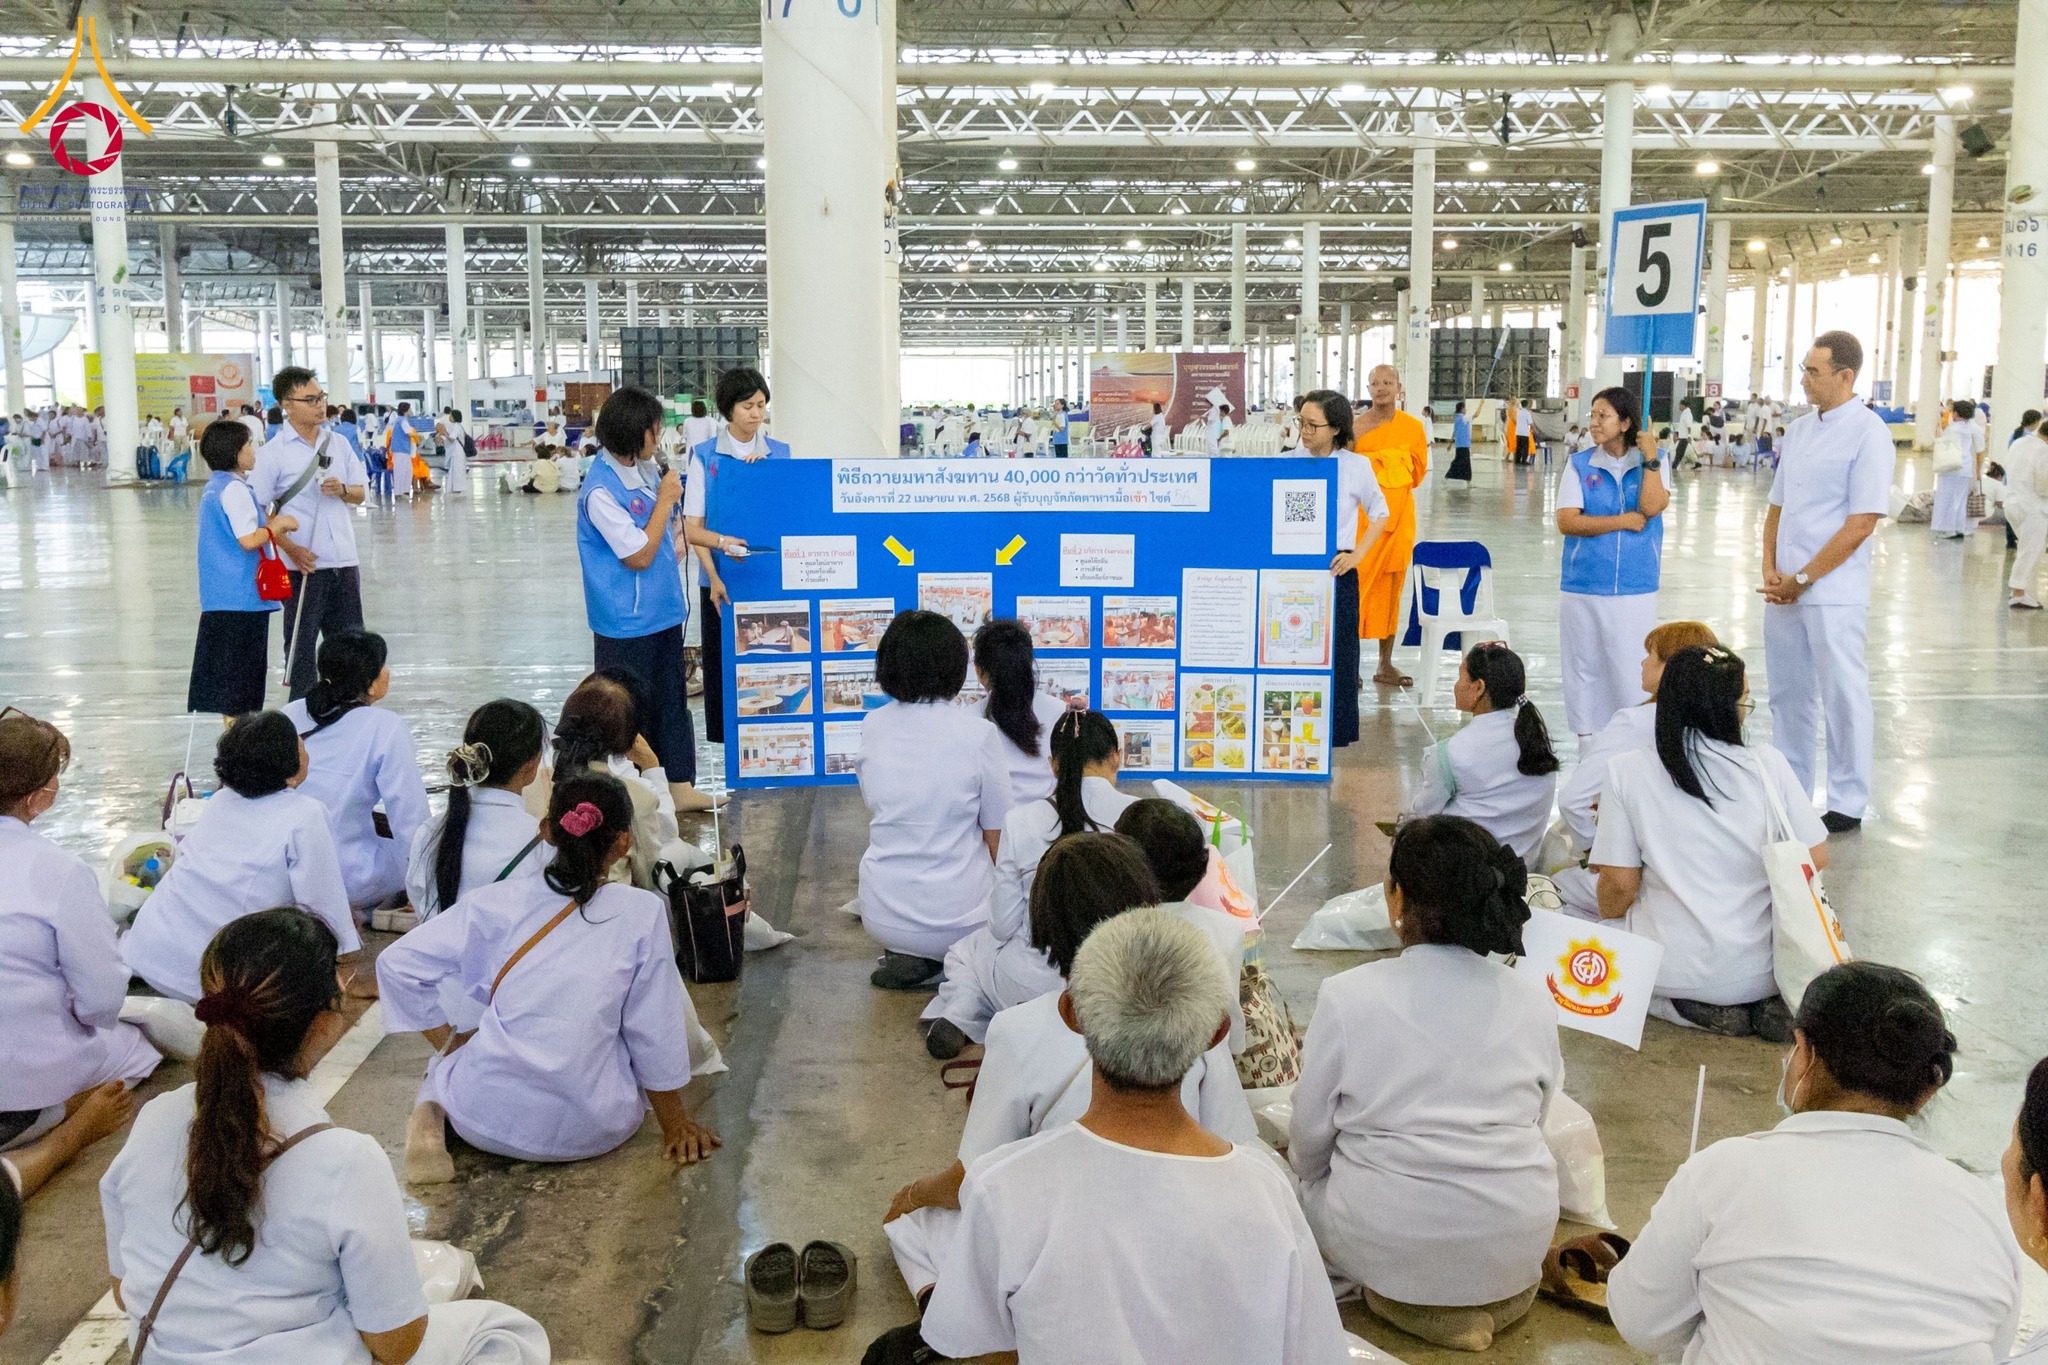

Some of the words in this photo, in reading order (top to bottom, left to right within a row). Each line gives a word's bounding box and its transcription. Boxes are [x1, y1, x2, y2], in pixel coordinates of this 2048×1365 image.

[2018, 243, 2037, 257] 16
[1636, 222, 1672, 308] 5
[837, 466, 999, 485] พิธีถวายมหาสังฆทาน
[1003, 469, 1060, 486] 40,000
[1065, 462, 1198, 484] กว่าวัดทั่วประเทศ
[840, 489, 895, 504] วันอังคารที่
[898, 494, 911, 503] 22
[914, 494, 956, 504] เมษายน
[958, 494, 980, 503] พ.ศ.
[984, 493, 1010, 503] 2568
[831, 549, 855, 558] (Food)
